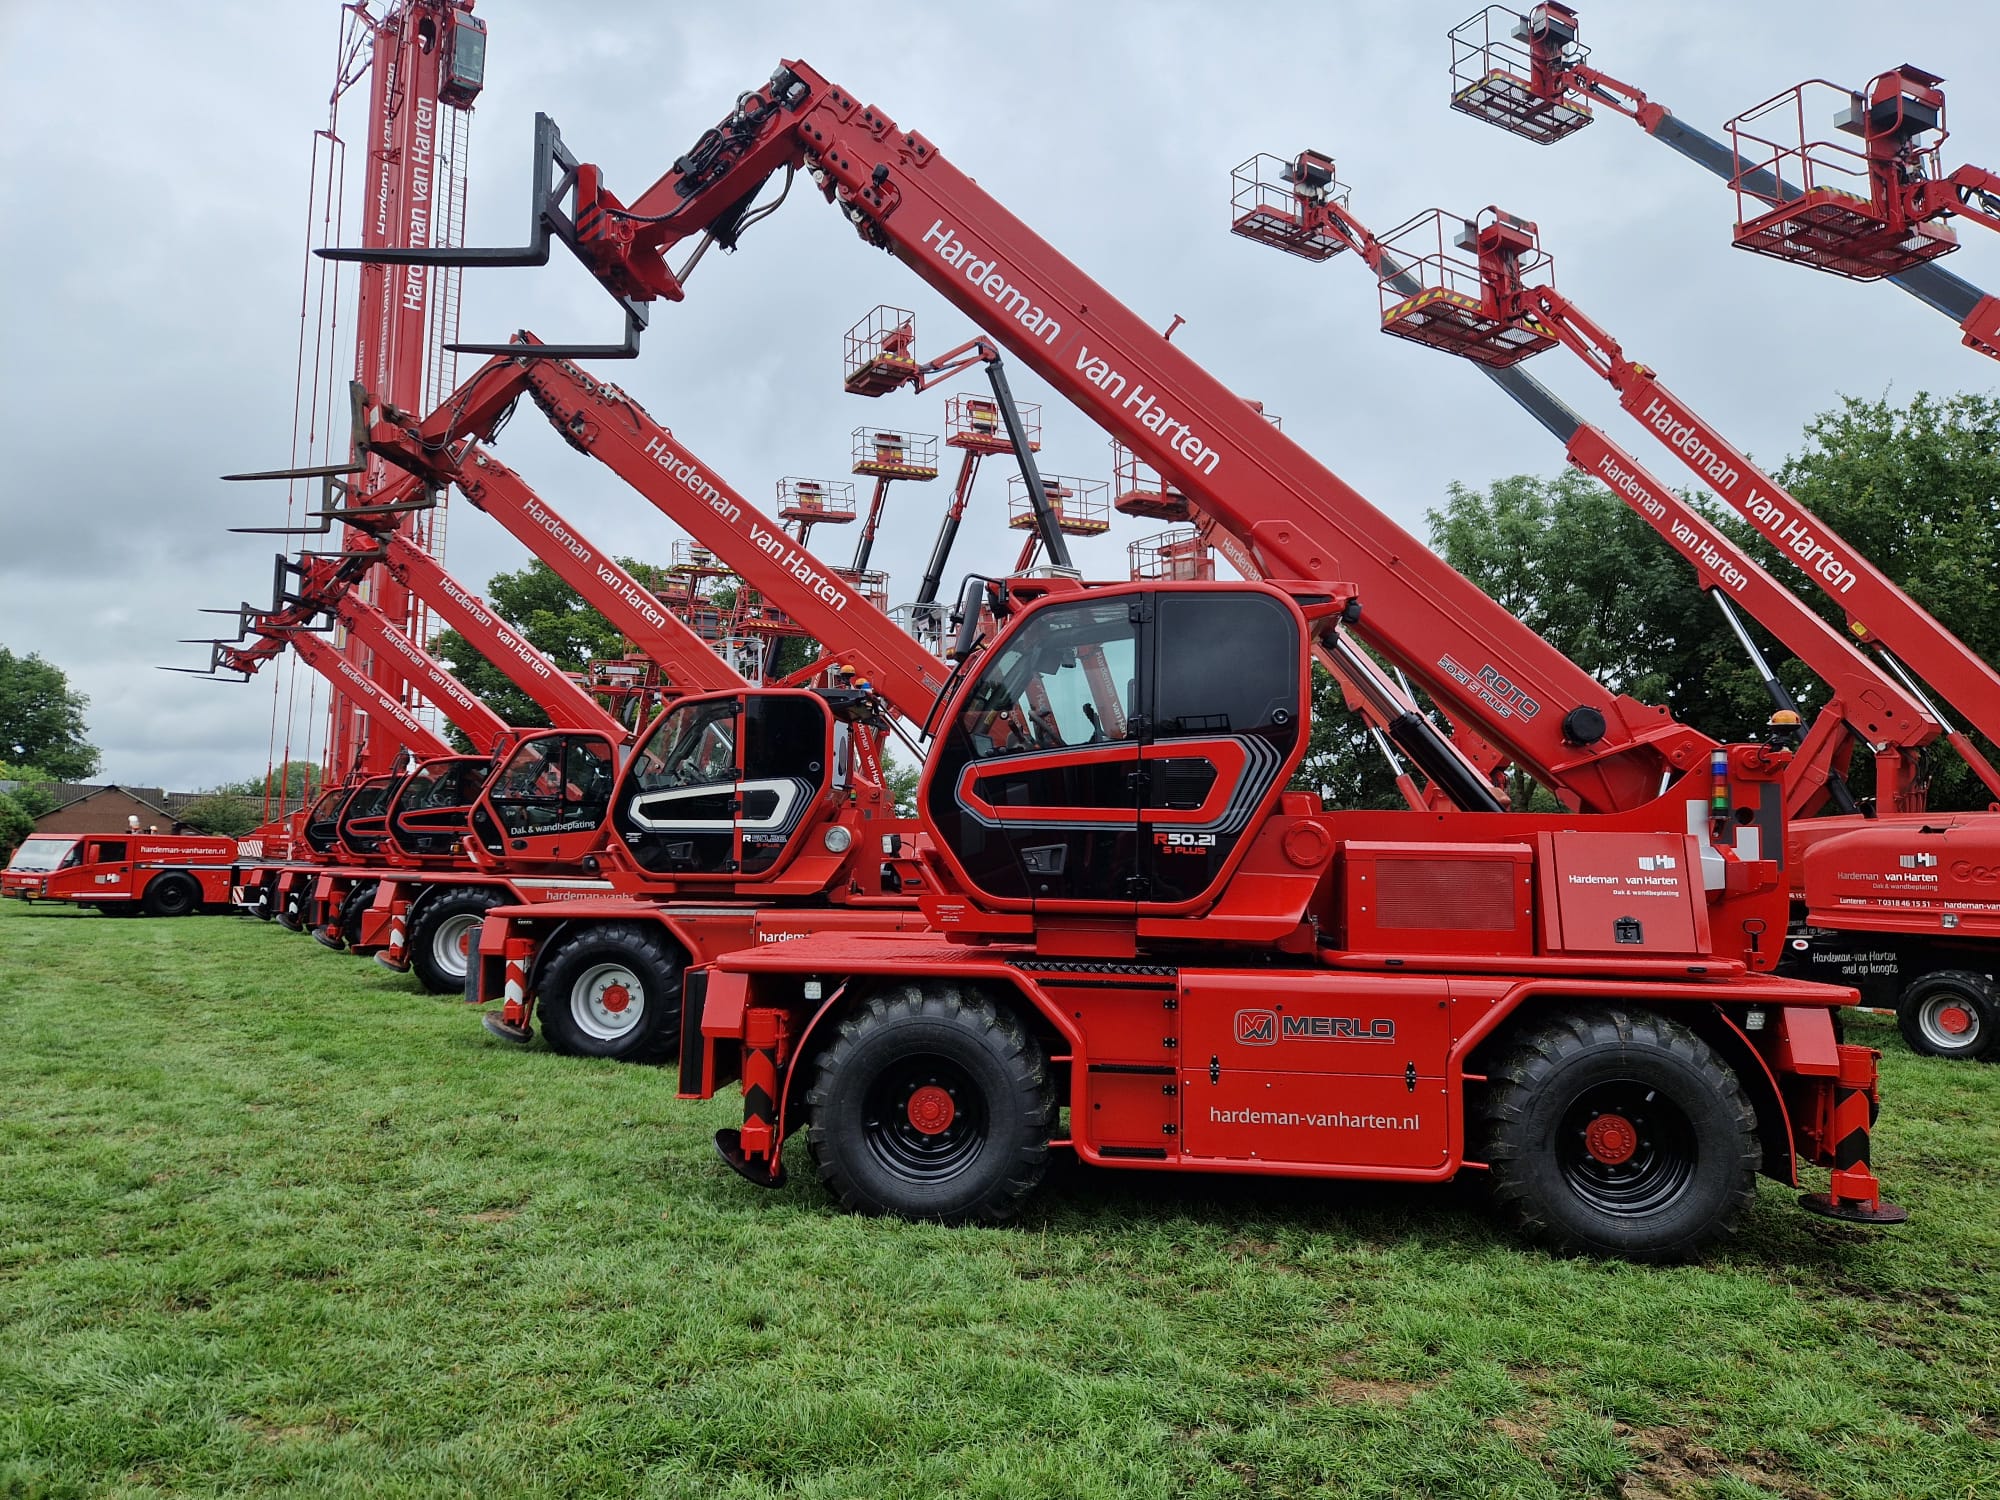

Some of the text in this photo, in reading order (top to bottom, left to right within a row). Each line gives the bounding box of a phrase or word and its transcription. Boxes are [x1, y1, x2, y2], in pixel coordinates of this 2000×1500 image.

[402, 97, 433, 311] Hardman van Harten
[922, 219, 1221, 475] Hardeman van Harten
[645, 436, 848, 612] Hardeman van Harten
[1598, 454, 1748, 592] Hardeman van Harten
[1641, 397, 1857, 594] Hardeman van Harten
[523, 498, 666, 629] Hardeman van Harten
[438, 577, 550, 679] Hardeman van Harten
[337, 661, 419, 733] Hardeman van Harten
[381, 626, 474, 711] Hardeman van Harten
[1437, 658, 1512, 718] 50.21 S PLUS
[1477, 663, 1541, 718] ROTO
[140, 845, 227, 855] hardeman-vanharten.nl
[1153, 833, 1216, 847] R50.21
[1162, 846, 1207, 855] S PLUS
[1568, 875, 1678, 885] Hardeman van Harten
[1837, 872, 1938, 882] Hardeman van Harten
[1840, 897, 1867, 905] Lunteren
[1883, 899, 1900, 907] 0318
[1858, 965, 1868, 975] op
[1870, 962, 1898, 975] hoogte
[1282, 1015, 1396, 1039] MERLO
[1210, 1106, 1420, 1130] hardeman-vanharten.nl
